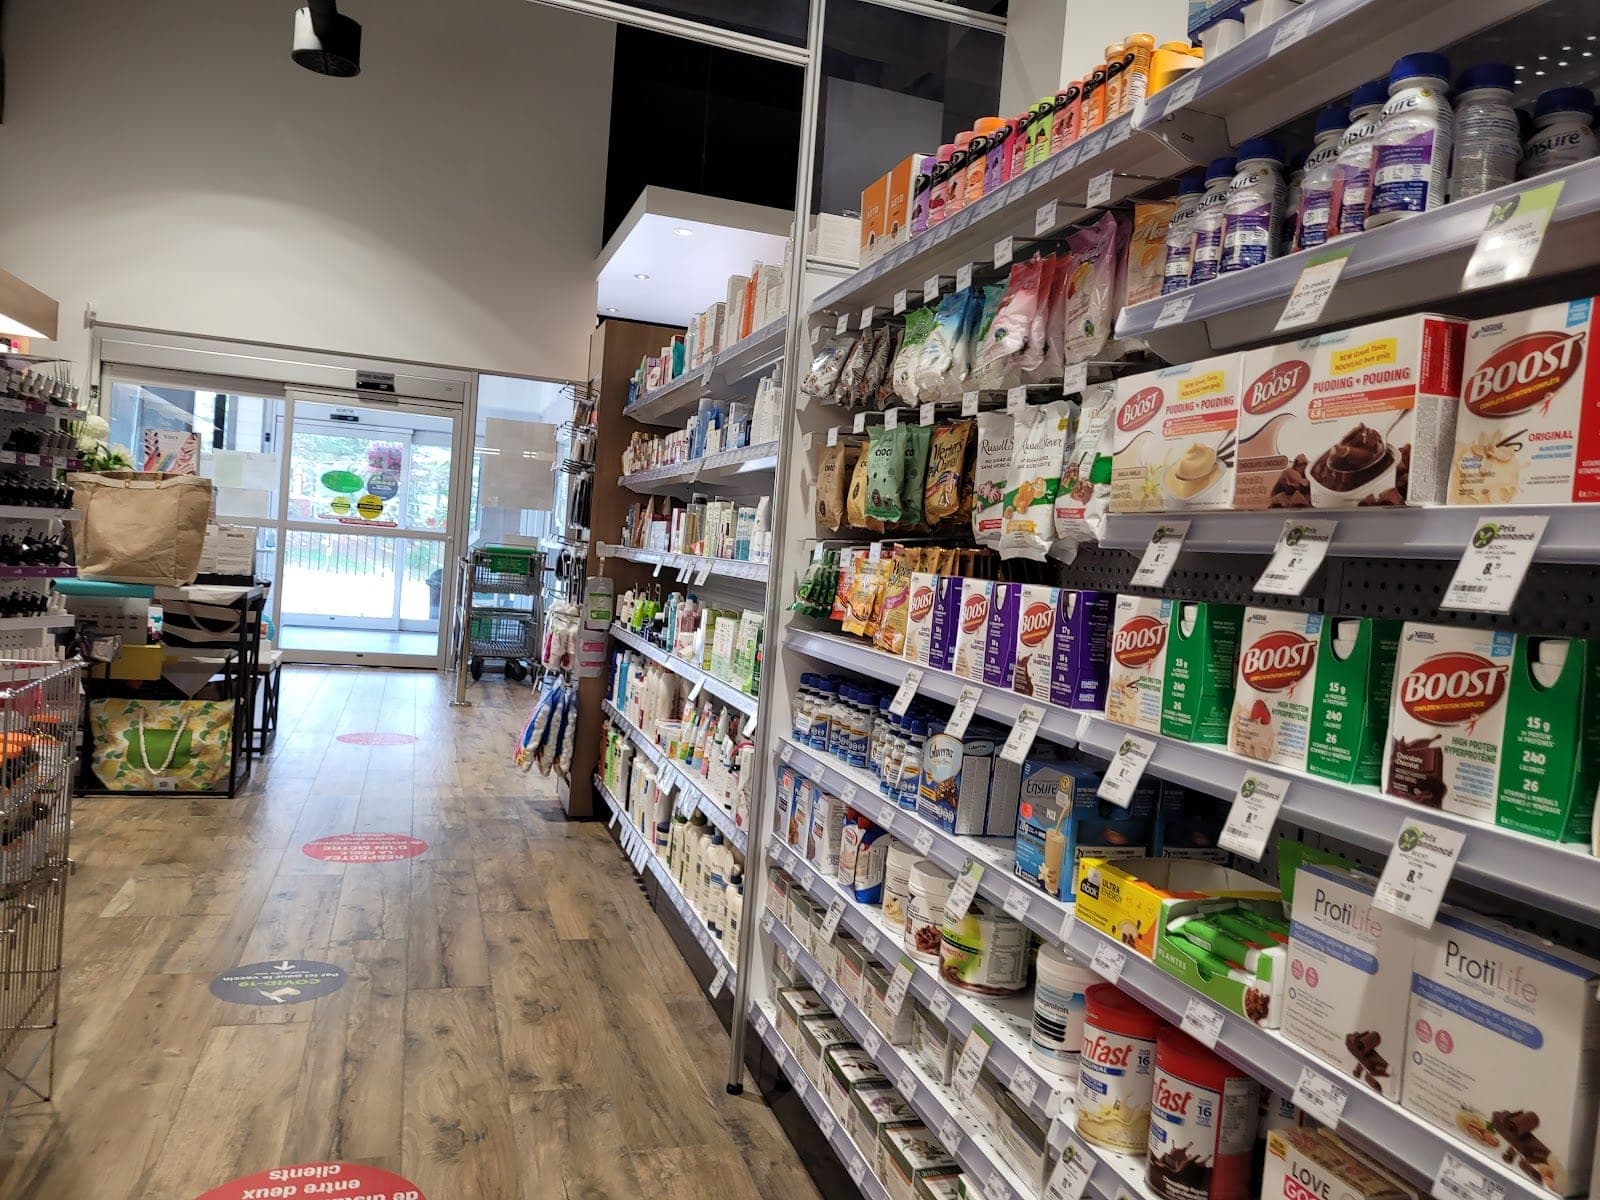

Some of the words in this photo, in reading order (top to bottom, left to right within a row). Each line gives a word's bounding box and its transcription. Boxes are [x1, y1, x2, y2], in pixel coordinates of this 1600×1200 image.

[1378, 96, 1419, 125] sure
[1469, 332, 1586, 403] BOOST
[1252, 367, 1302, 406] BOOST
[1313, 376, 1353, 393] PUDDING
[1363, 367, 1410, 386] POUDING
[1123, 391, 1160, 426] BOOST
[1166, 400, 1194, 415] PUDDING
[1201, 395, 1234, 410] POUDING
[1528, 430, 1573, 442] ORIGINAL
[1021, 609, 1055, 633] BOOST
[1116, 623, 1168, 652] BOOST
[1244, 640, 1317, 673] BOOST
[1329, 682, 1340, 692] 15
[1405, 665, 1509, 703] BOOST
[1326, 710, 1342, 722] 240
[1526, 716, 1541, 728] 15
[1542, 722, 1550, 733] g
[1326, 733, 1337, 744] 26
[1452, 736, 1468, 747] HIGH
[1469, 740, 1498, 753] PROTEIN
[1522, 751, 1546, 765] 240
[1027, 779, 1059, 795] Ensure
[1523, 779, 1539, 792] 26
[1102, 879, 1120, 894] ULTRA
[1314, 888, 1384, 939] ProtiLife
[1445, 940, 1538, 1003] ProtiLife
[239, 978, 320, 988] COVID-19
[1138, 1056, 1150, 1066] 16
[1198, 1106, 1212, 1117] 16
[269, 1165, 341, 1181] clients
[1292, 1161, 1331, 1199] LOVE
[242, 1185, 296, 1200] deux
[304, 1179, 360, 1195] entre
